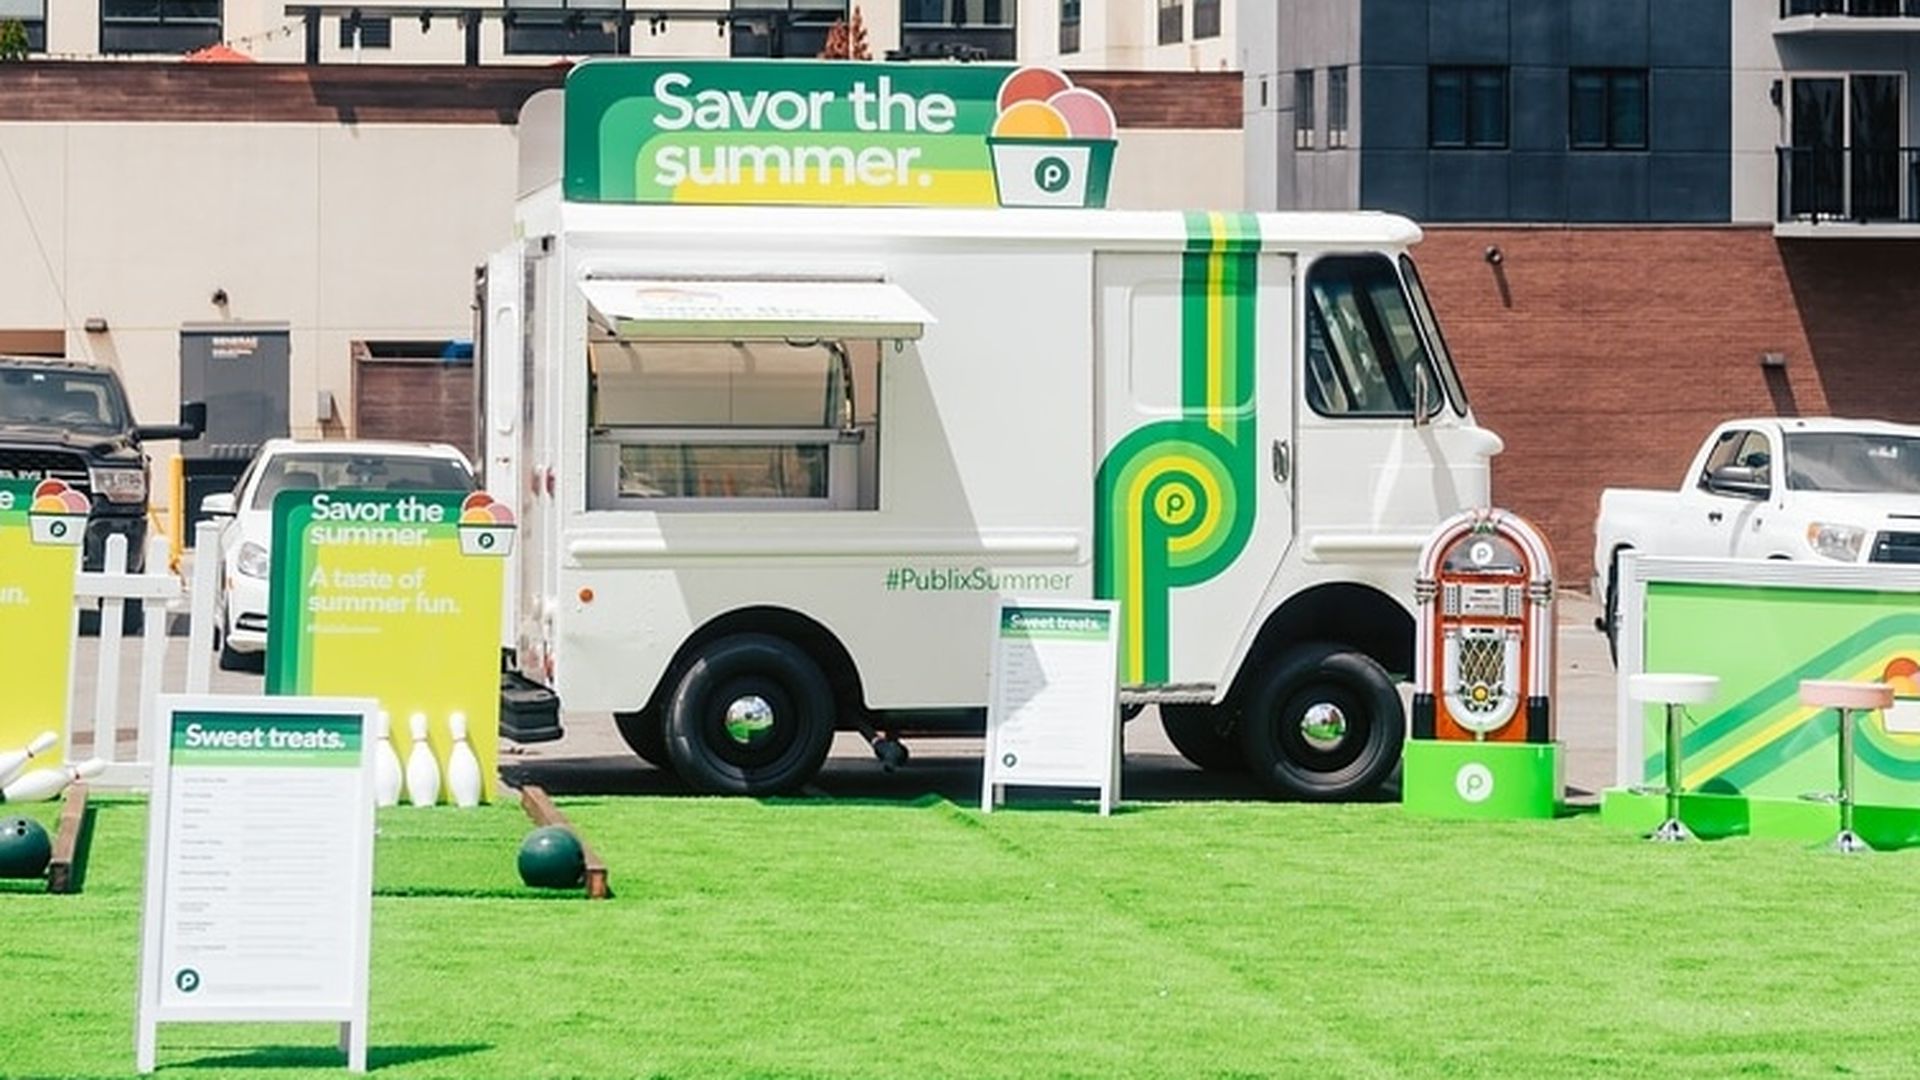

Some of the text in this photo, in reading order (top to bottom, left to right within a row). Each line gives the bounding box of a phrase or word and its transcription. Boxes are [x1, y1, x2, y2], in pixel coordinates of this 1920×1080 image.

[652, 71, 957, 133] Savor the
[653, 143, 933, 188] summer.
[311, 493, 444, 522] Savor the
[309, 525, 431, 546] summer.
[308, 566, 426, 589] A taste of
[884, 567, 1074, 592] #PublixSummer
[307, 592, 461, 614] summer fun.
[1010, 613, 1102, 631] Sweet treats.
[184, 723, 346, 750] Sweet treats.
